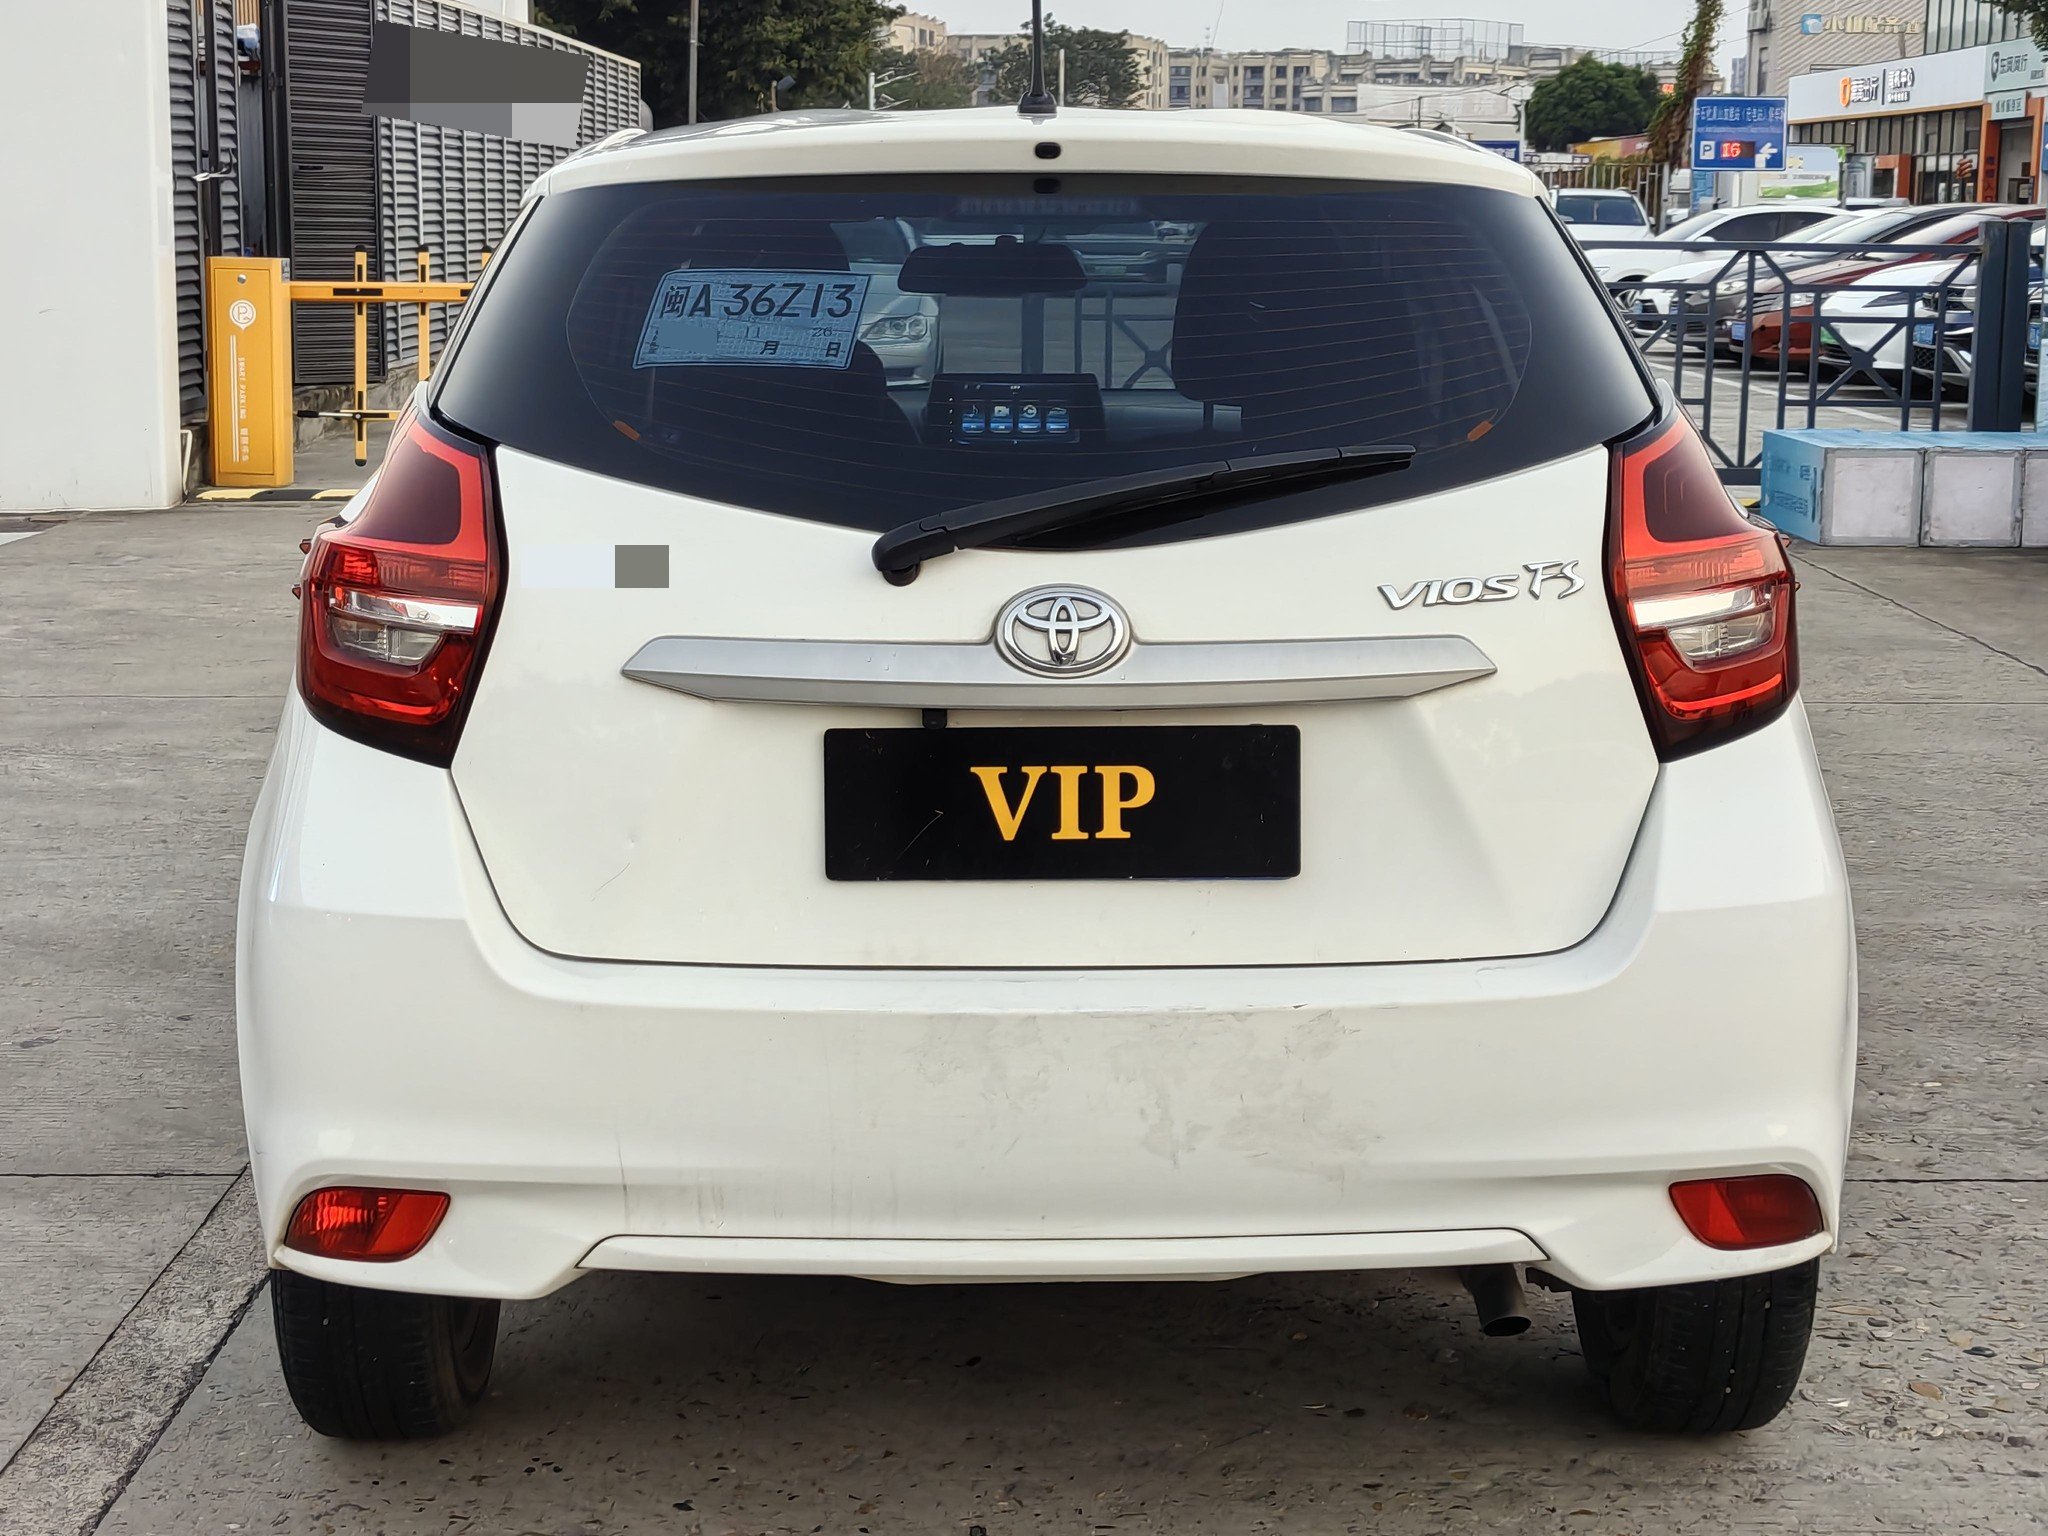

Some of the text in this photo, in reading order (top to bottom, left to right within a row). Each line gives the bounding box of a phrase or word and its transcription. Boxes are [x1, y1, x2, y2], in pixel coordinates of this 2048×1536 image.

[1702, 144, 1712, 156] P
[1377, 574, 1519, 610] VIOS
[970, 765, 1155, 841] VIP
